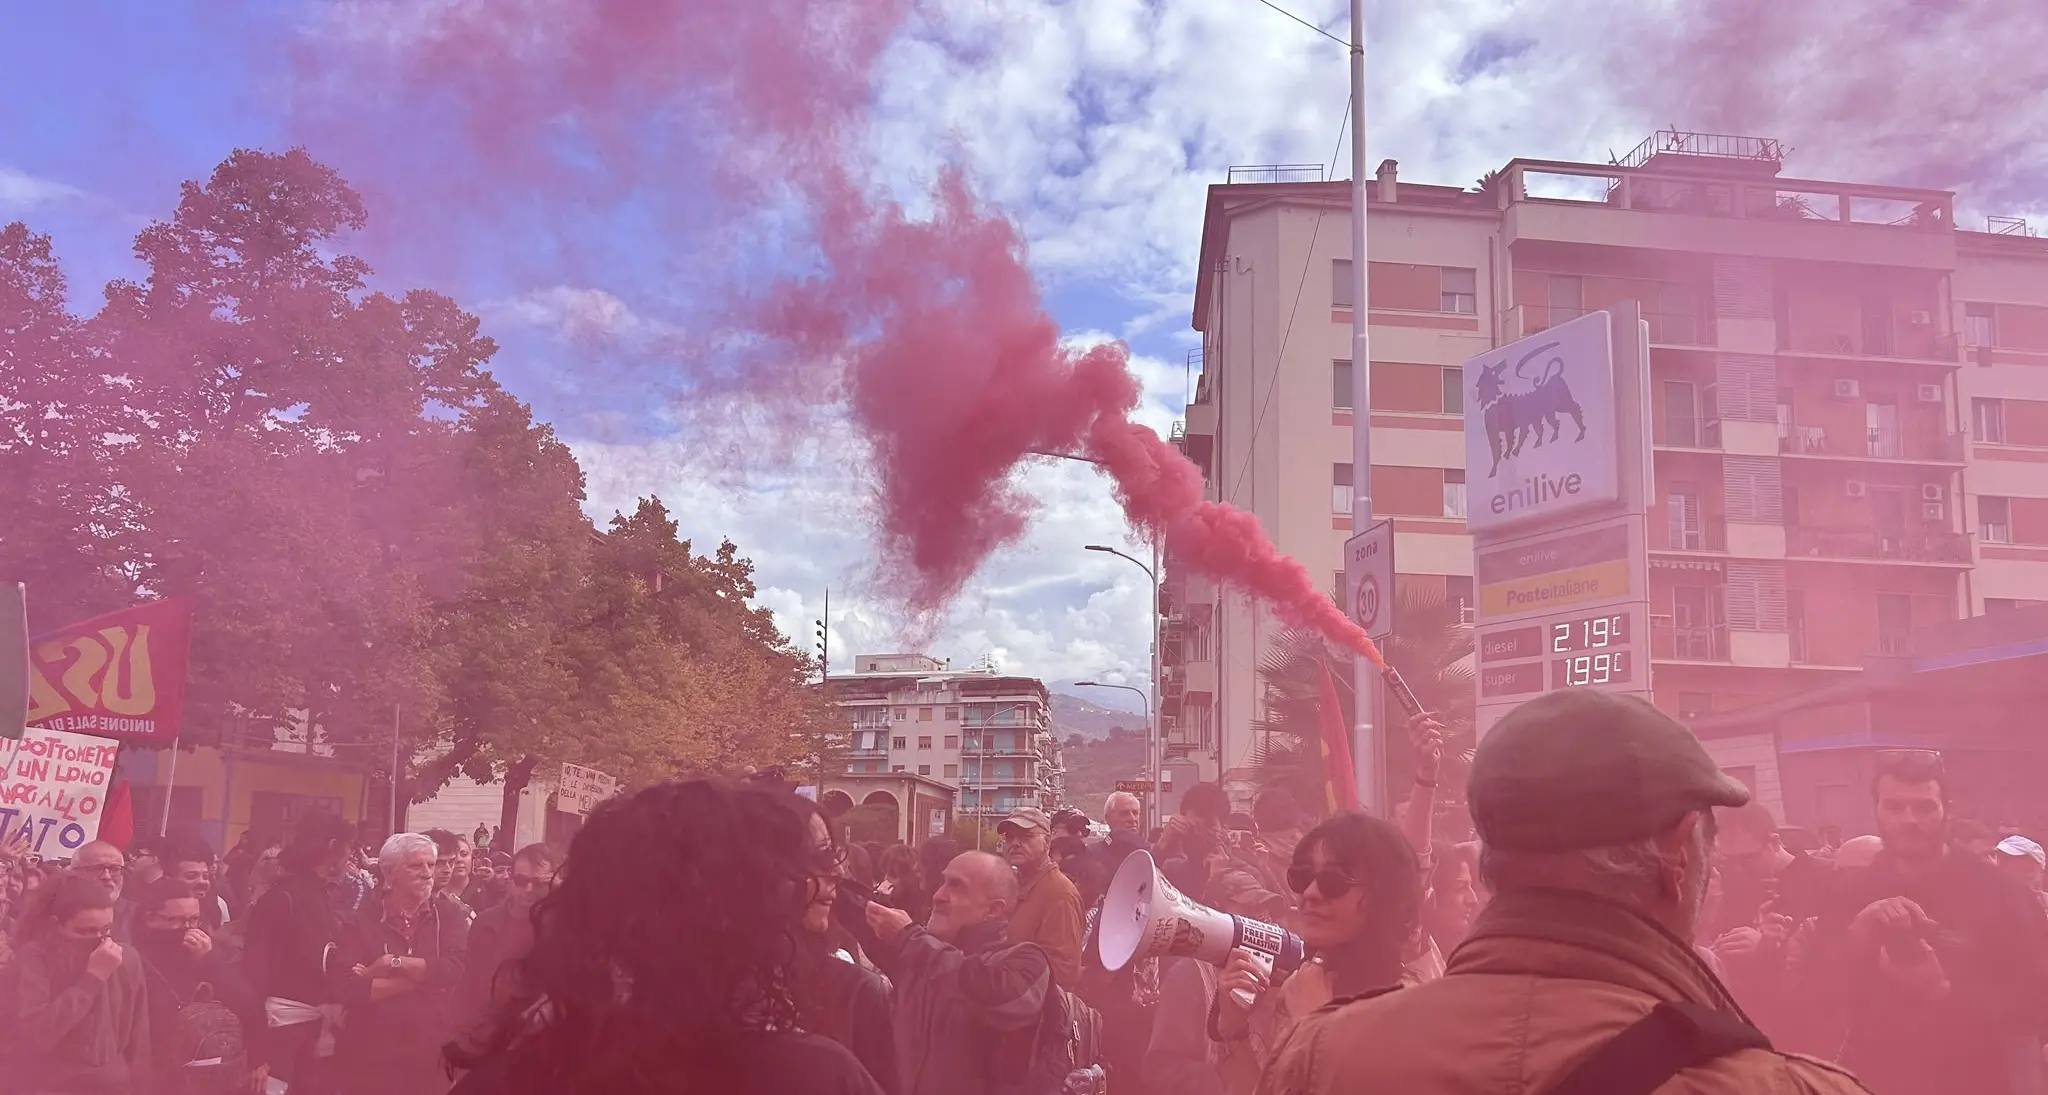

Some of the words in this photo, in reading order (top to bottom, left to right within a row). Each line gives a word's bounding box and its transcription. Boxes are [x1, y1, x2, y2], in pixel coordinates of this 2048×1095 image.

[1490, 473, 1582, 514] enilive
[1355, 541, 1378, 562] zona
[1519, 550, 1558, 566] enilive
[1360, 588, 1375, 616] 30
[1506, 578, 1599, 609] Posteitaliane
[1484, 636, 1517, 654] diesel
[1484, 672, 1517, 687] super
[17, 758, 49, 781] UN
[1244, 926, 1265, 940] FREE
[1243, 934, 1280, 953] PALESTINE
